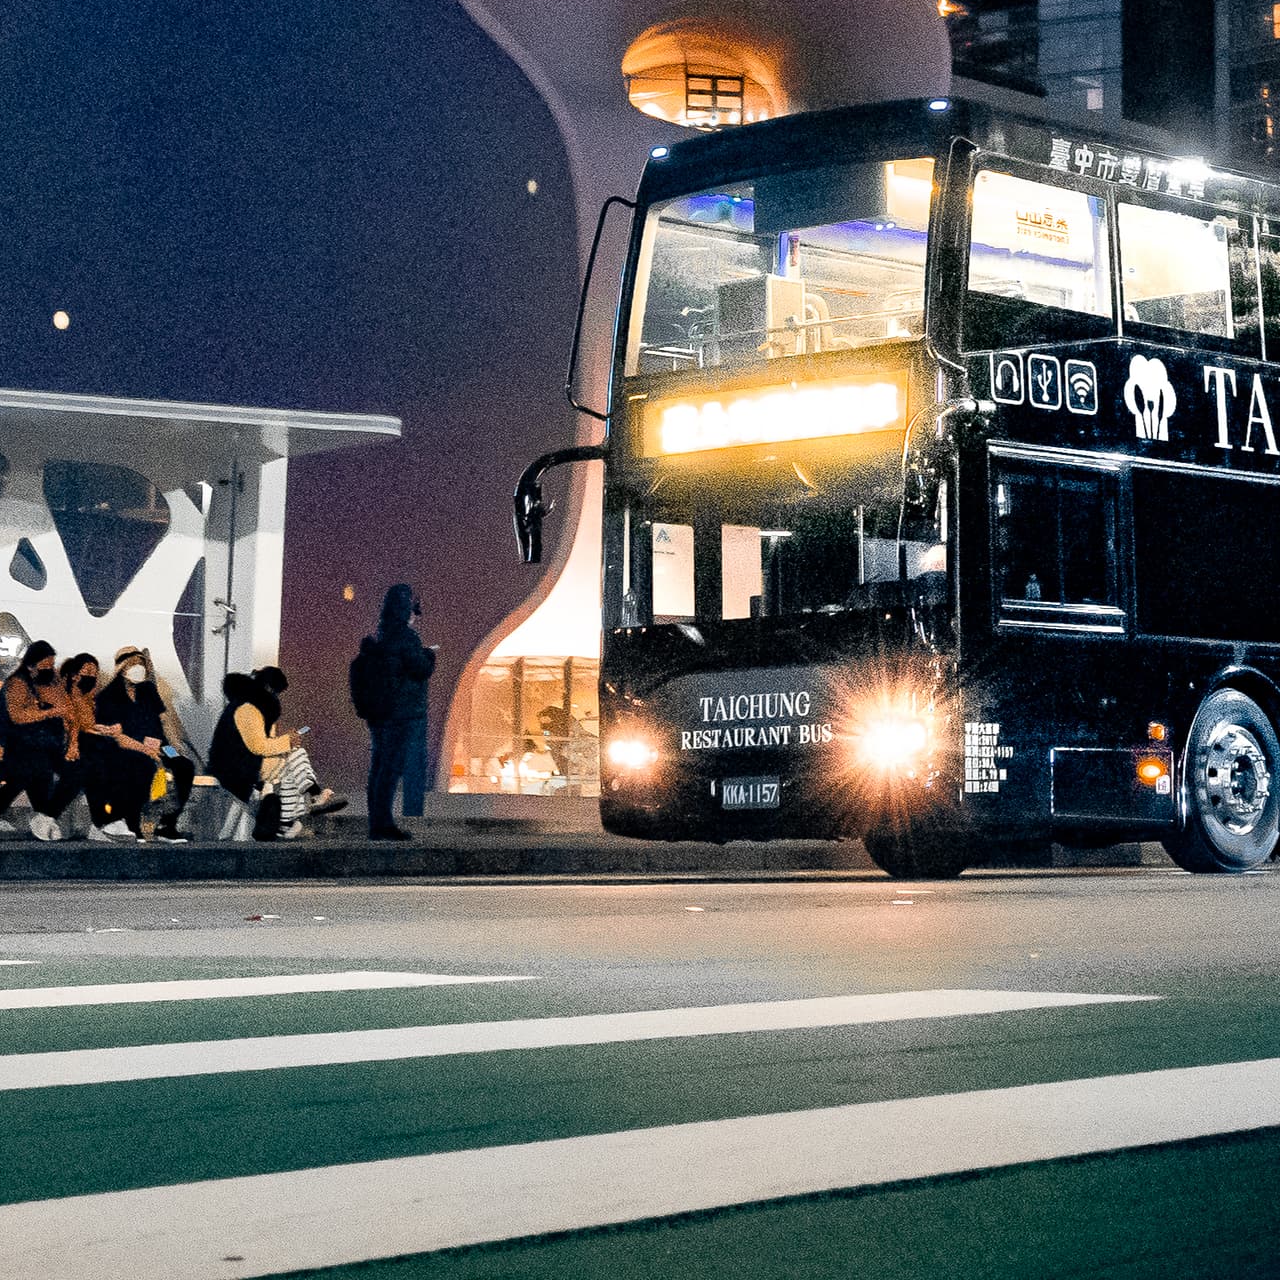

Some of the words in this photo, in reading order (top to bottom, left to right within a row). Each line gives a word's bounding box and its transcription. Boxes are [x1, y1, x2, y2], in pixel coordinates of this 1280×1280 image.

[700, 691, 811, 721] TAICHUNG
[681, 725, 791, 750] RESTAURANT
[799, 723, 833, 744] BUS
[722, 783, 778, 805] KKA-1157
